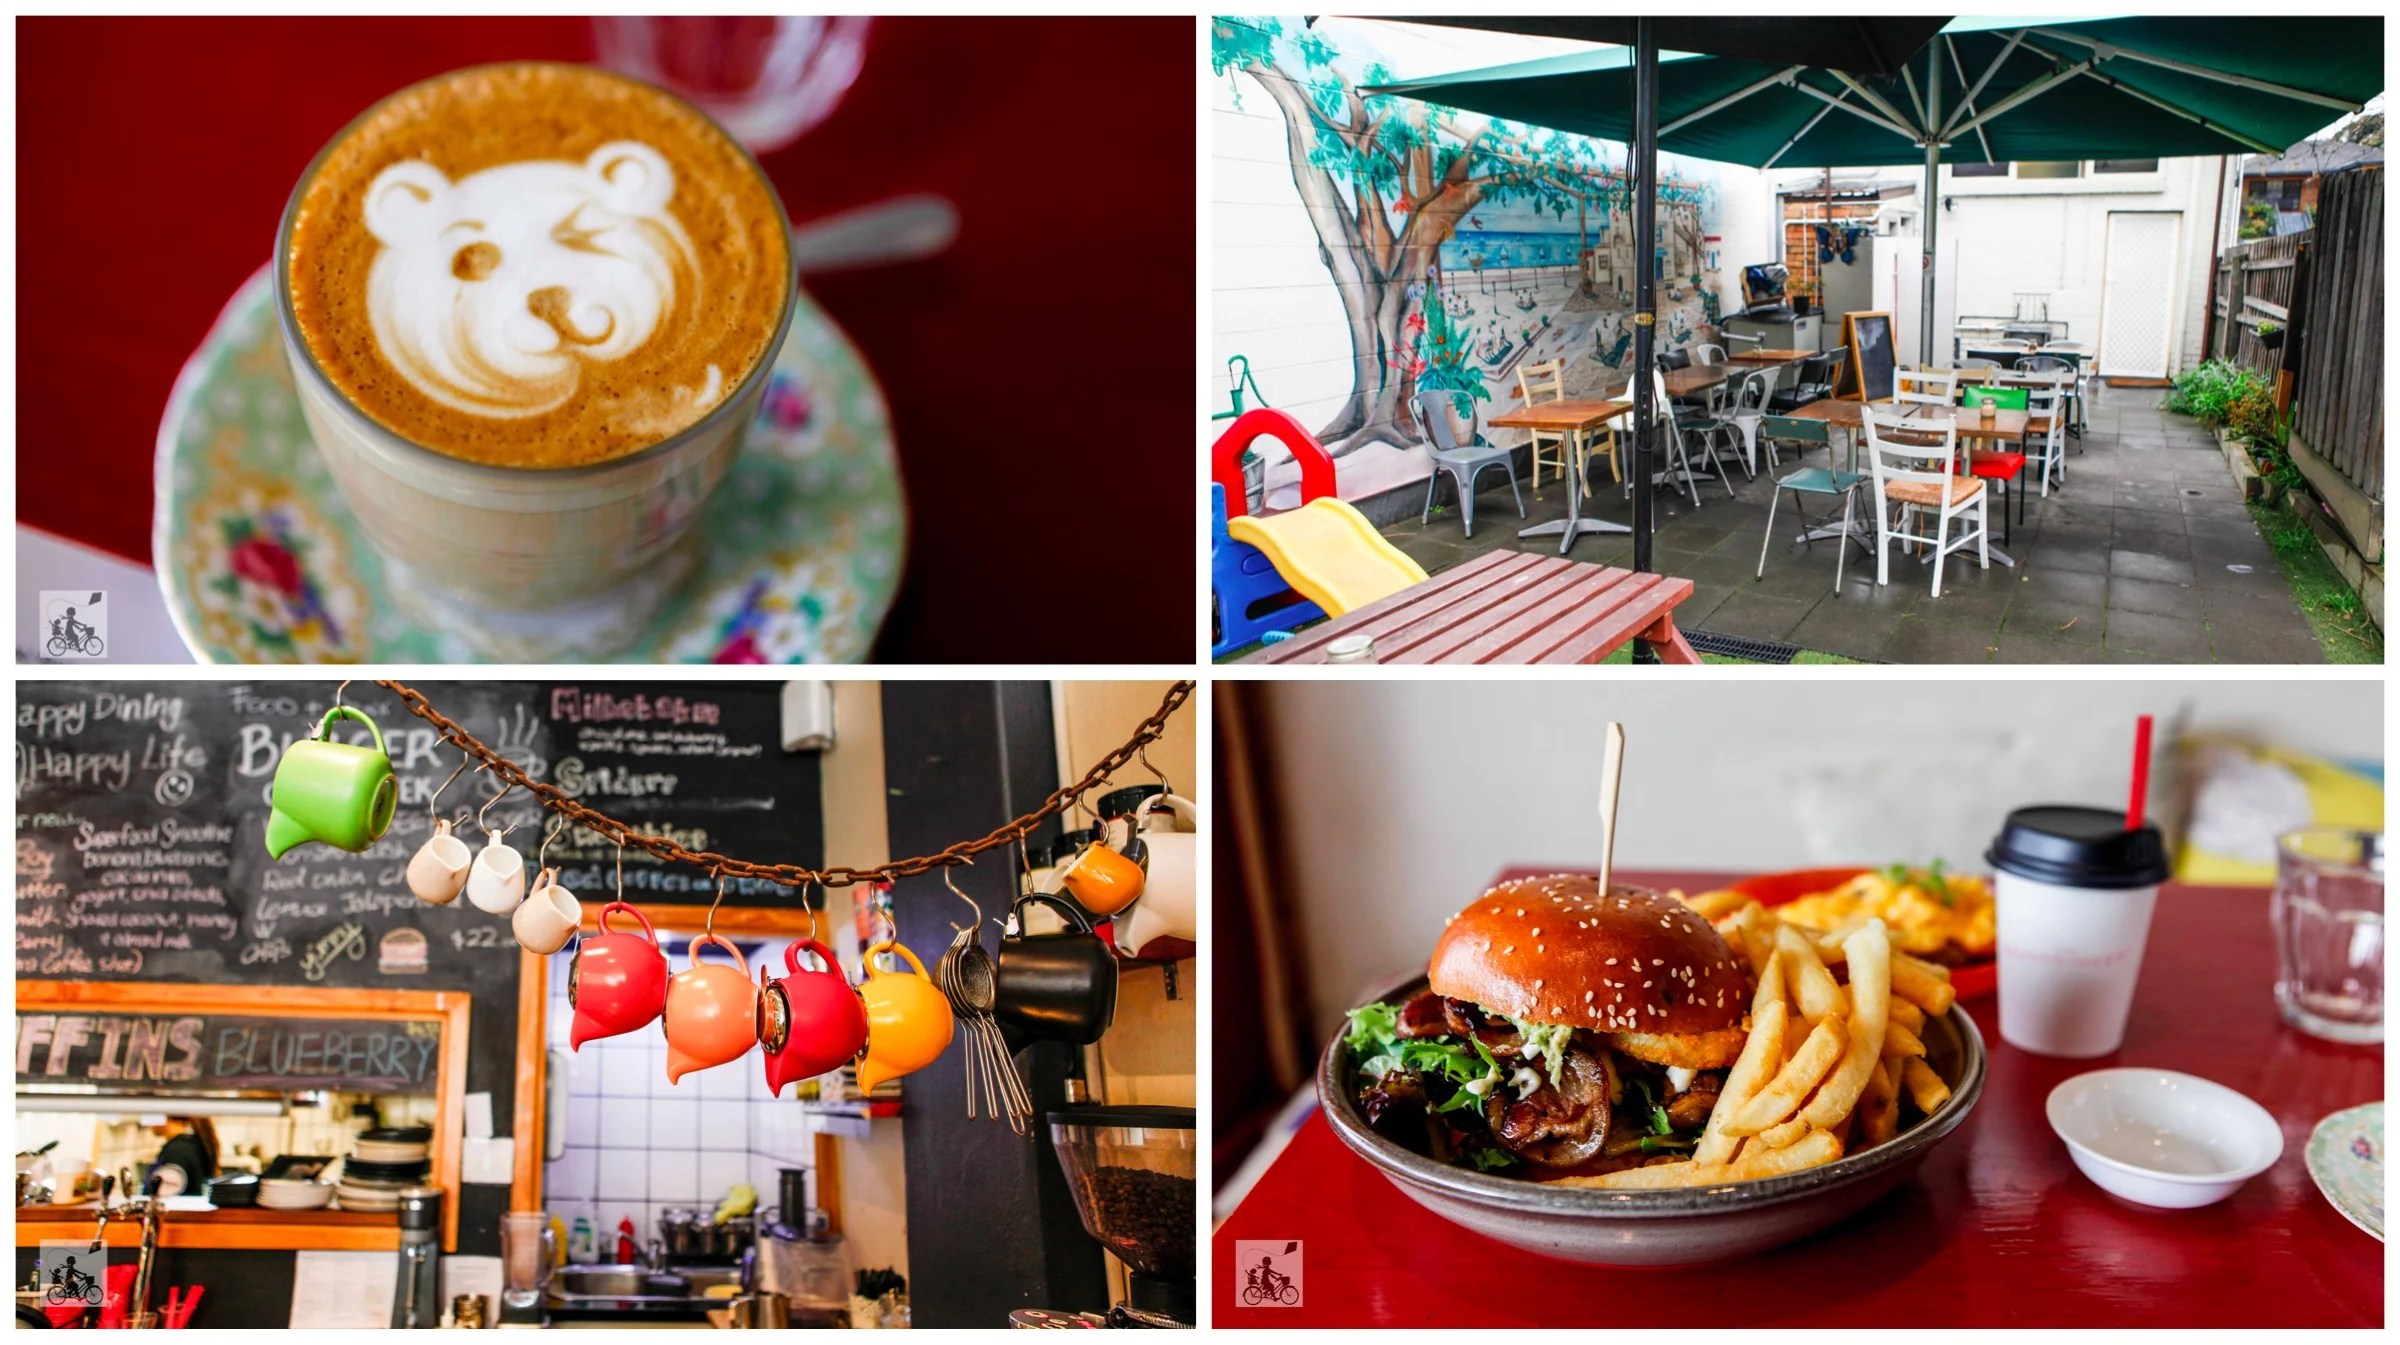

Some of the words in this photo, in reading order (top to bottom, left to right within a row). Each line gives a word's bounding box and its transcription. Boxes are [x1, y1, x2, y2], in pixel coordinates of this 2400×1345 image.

[93, 692, 184, 732] Dining
[28, 743, 131, 793] Happy
[141, 733, 207, 771] Life
[16, 1016, 204, 1081] FFINS
[215, 1027, 438, 1081] BLUEBERRY
